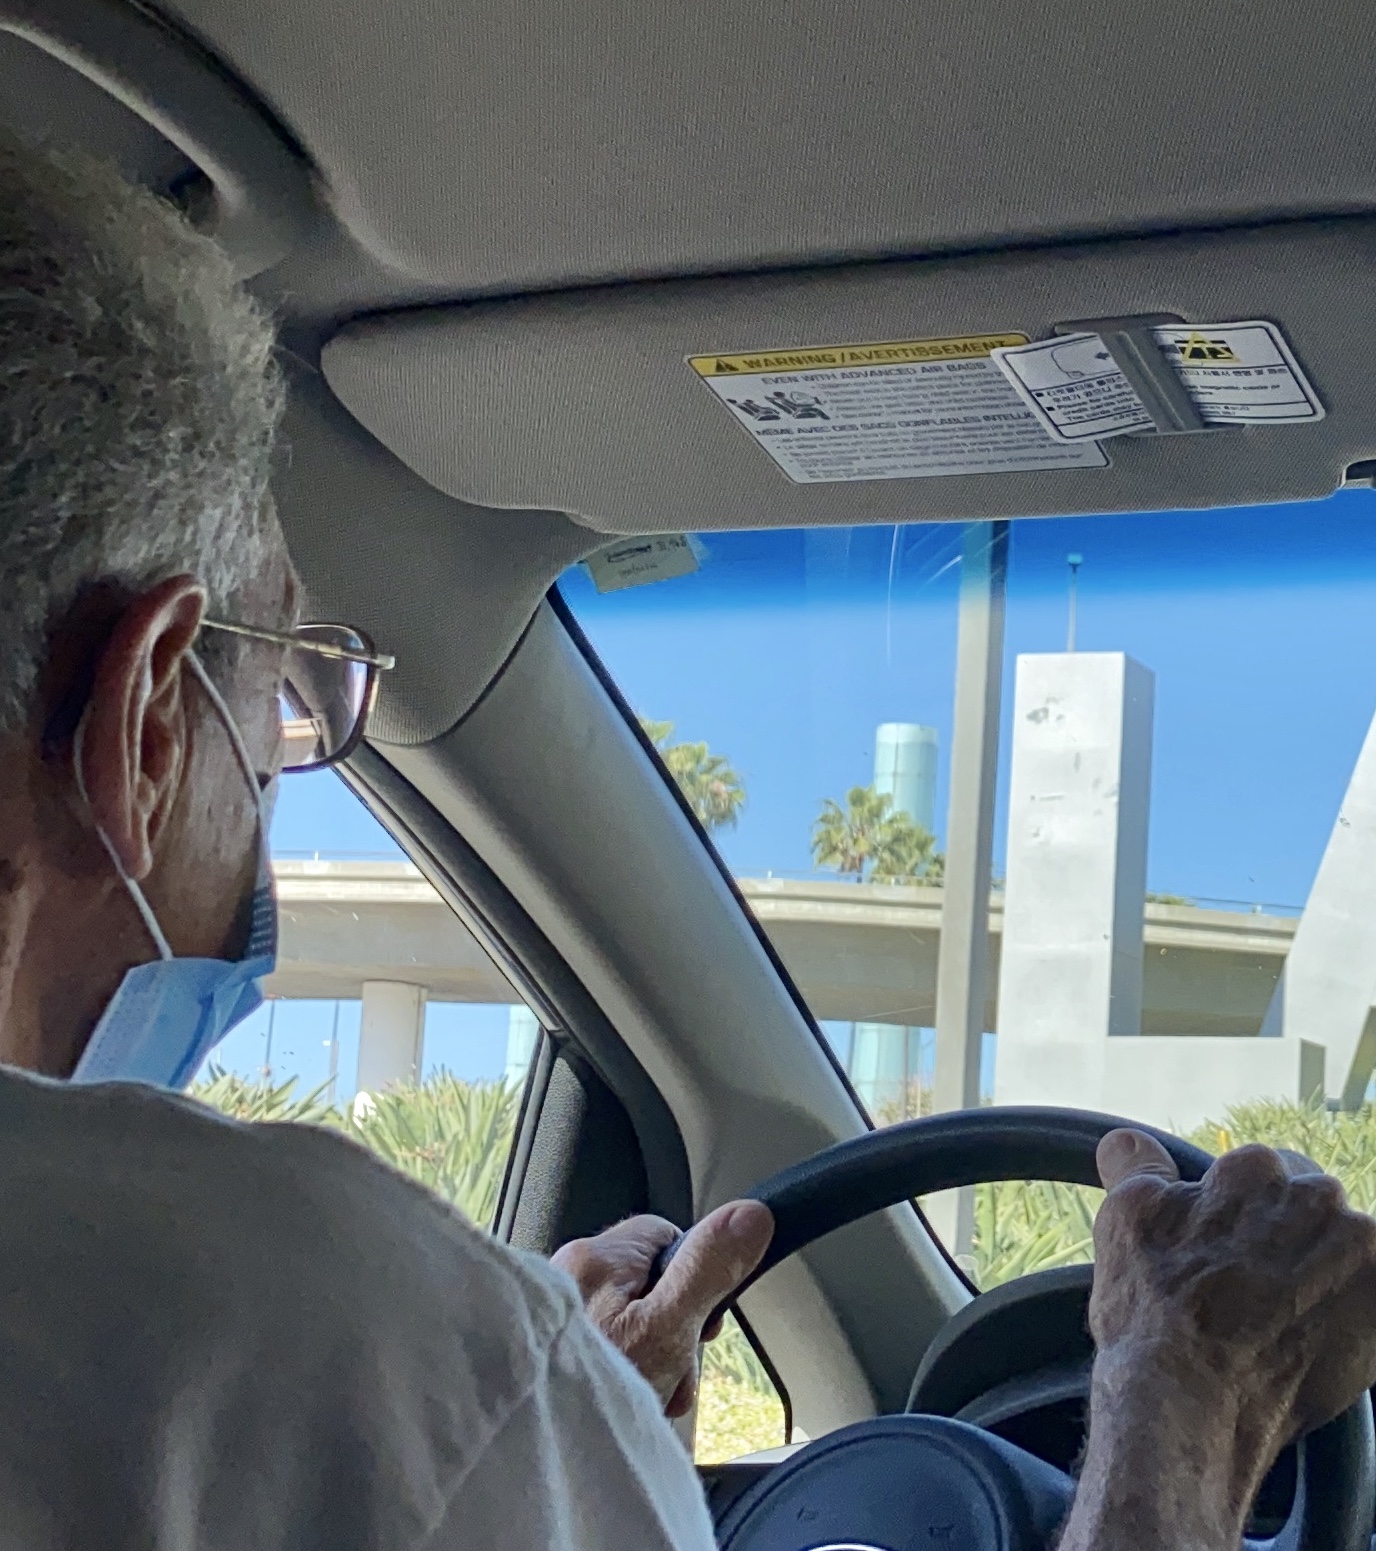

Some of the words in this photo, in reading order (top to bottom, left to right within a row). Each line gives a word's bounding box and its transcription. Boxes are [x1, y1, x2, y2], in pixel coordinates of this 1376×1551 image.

[742, 351, 836, 369] WARNING
[849, 340, 1006, 362] AVERTISSEMENT
[761, 375, 799, 386] EVEN
[801, 372, 837, 383] WITH
[838, 366, 917, 380] ADVANCED
[921, 364, 945, 375] AIR
[947, 361, 987, 373] BAGS
